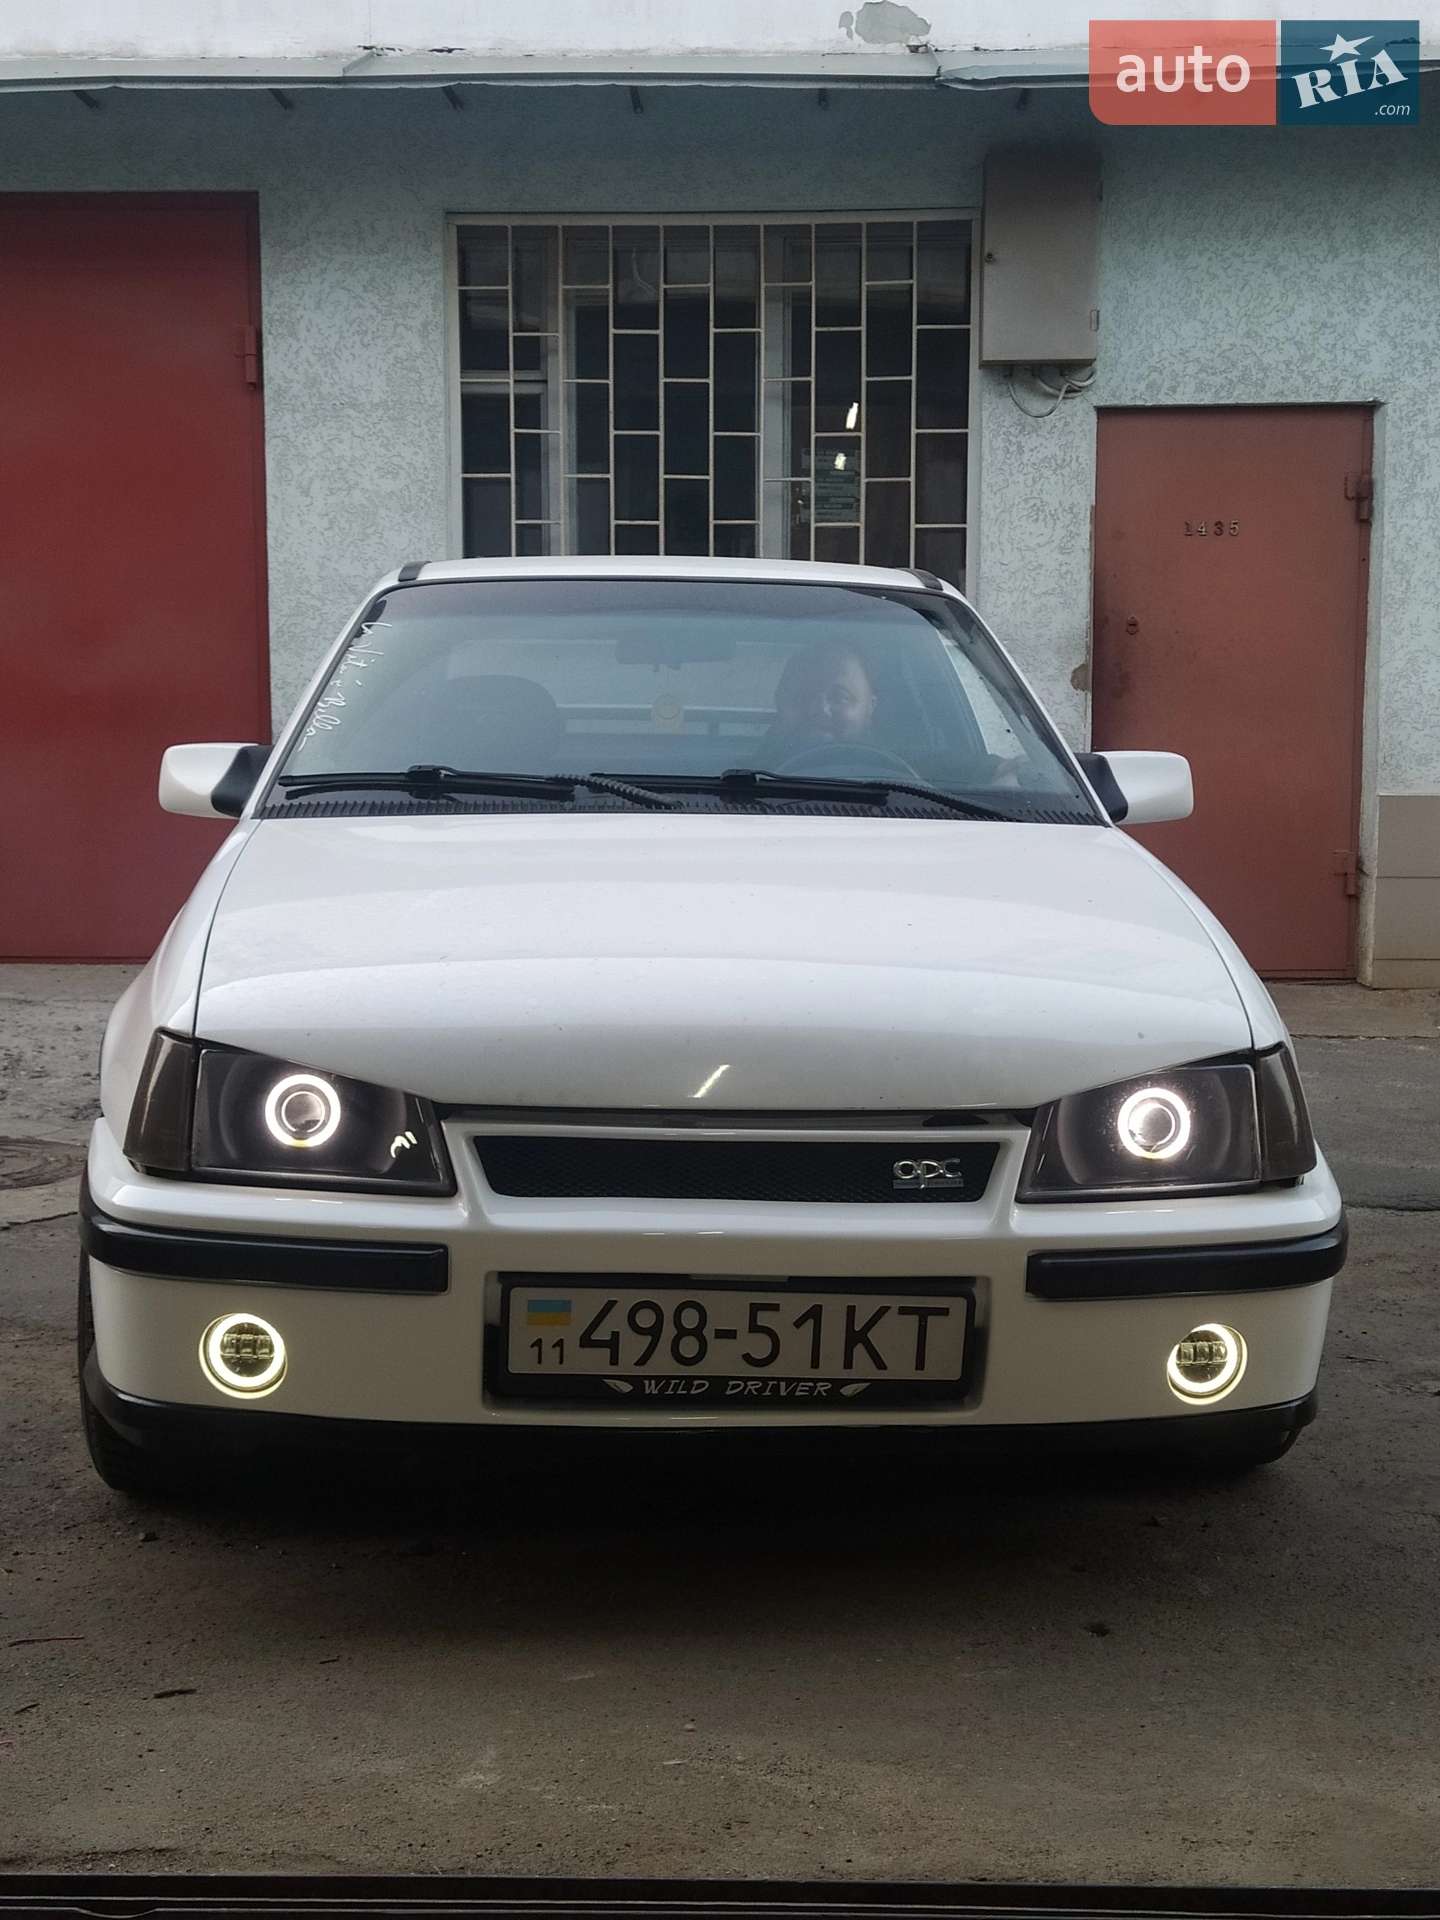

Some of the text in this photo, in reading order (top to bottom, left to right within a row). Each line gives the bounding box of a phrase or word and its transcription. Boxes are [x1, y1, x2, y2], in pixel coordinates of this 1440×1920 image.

[1184, 520, 1239, 537] 1435
[579, 1299, 950, 1371] 498-51KT
[529, 1337, 564, 1366] 11
[643, 1380, 832, 1397] WILD DRIVER
